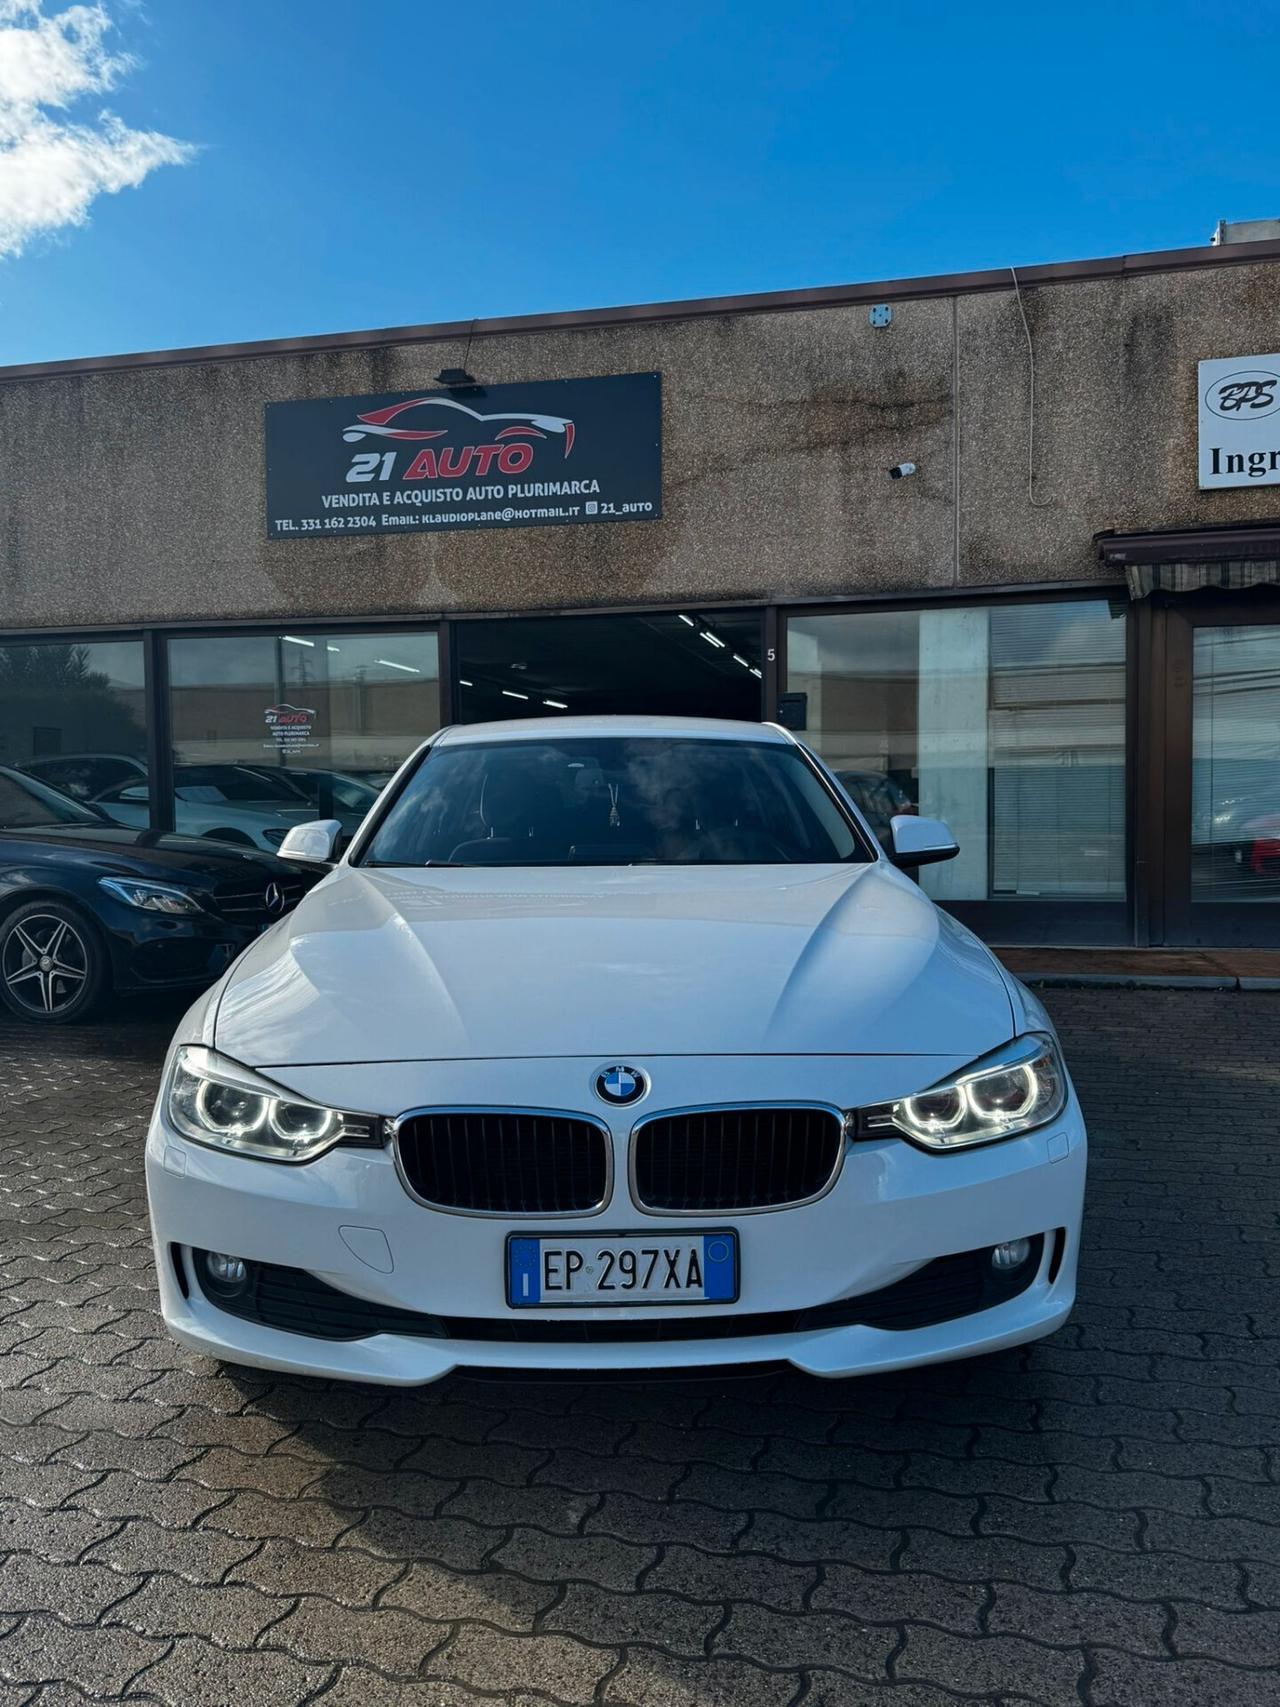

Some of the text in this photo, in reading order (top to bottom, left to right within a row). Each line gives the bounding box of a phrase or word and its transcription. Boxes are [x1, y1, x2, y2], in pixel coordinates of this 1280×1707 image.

[345, 443, 534, 483] 21 AUTO
[321, 479, 601, 509] VENDITA E ACQUISTO AUTO PLURIMARCA
[275, 519, 299, 532] TEL.
[300, 518, 321, 530] 331
[324, 517, 345, 529] 162
[346, 515, 376, 528] 2304
[767, 648, 776, 661] 5
[265, 714, 307, 724] 21 AUTO
[600, 1066, 641, 1079] BMW
[544, 1248, 703, 1290] EP 297XA
